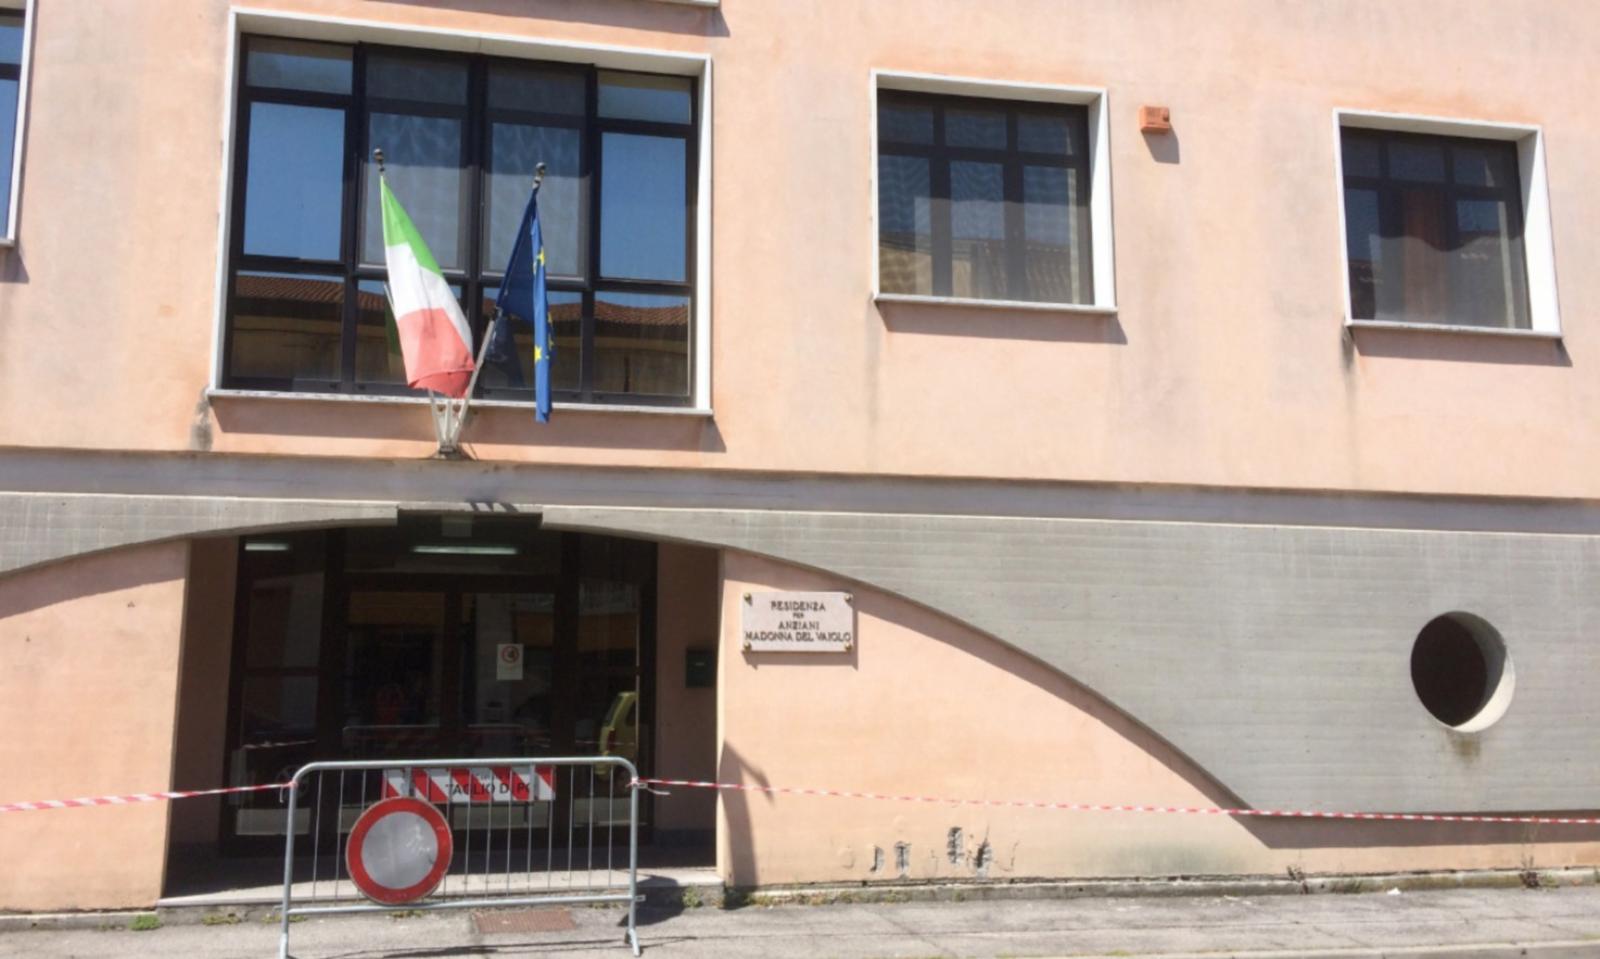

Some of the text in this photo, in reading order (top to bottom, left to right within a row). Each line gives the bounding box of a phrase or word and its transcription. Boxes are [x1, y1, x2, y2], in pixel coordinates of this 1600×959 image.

[770, 601, 826, 611] RESIDENZA
[778, 621, 820, 631] ANZIANI
[745, 632, 794, 642] MADONNA
[796, 632, 814, 642] DEL
